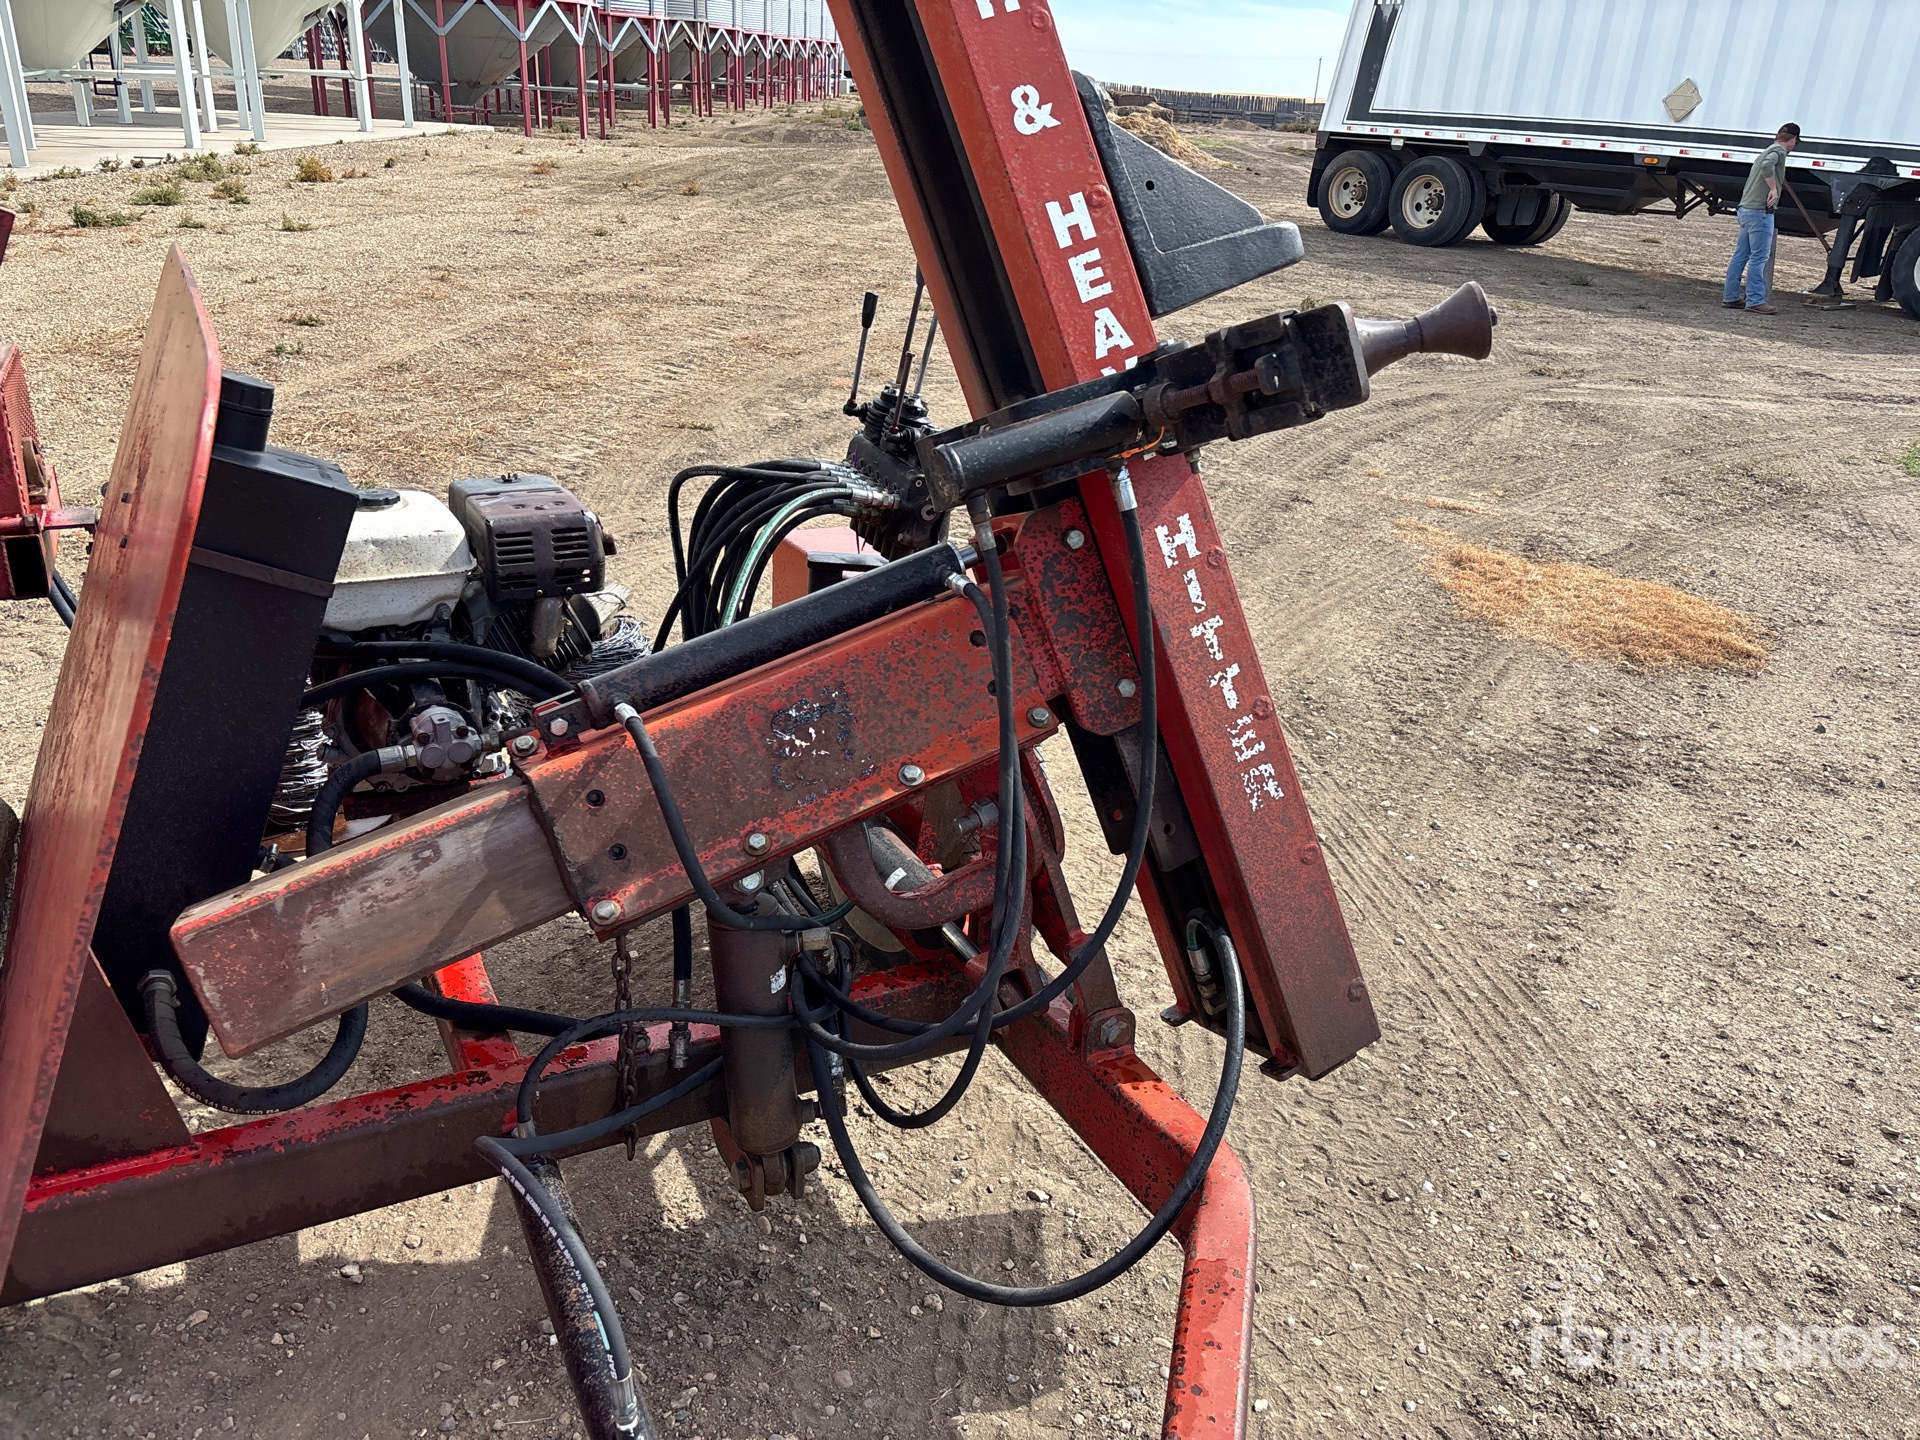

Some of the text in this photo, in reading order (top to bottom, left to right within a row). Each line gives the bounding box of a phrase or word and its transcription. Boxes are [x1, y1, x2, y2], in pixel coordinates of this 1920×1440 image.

[1010, 84, 1285, 812] & HEA HITTER
[172, 1075, 202, 1101] PULSAR
[204, 1099, 218, 1109] 141
[556, 1238, 566, 1250] PSI
